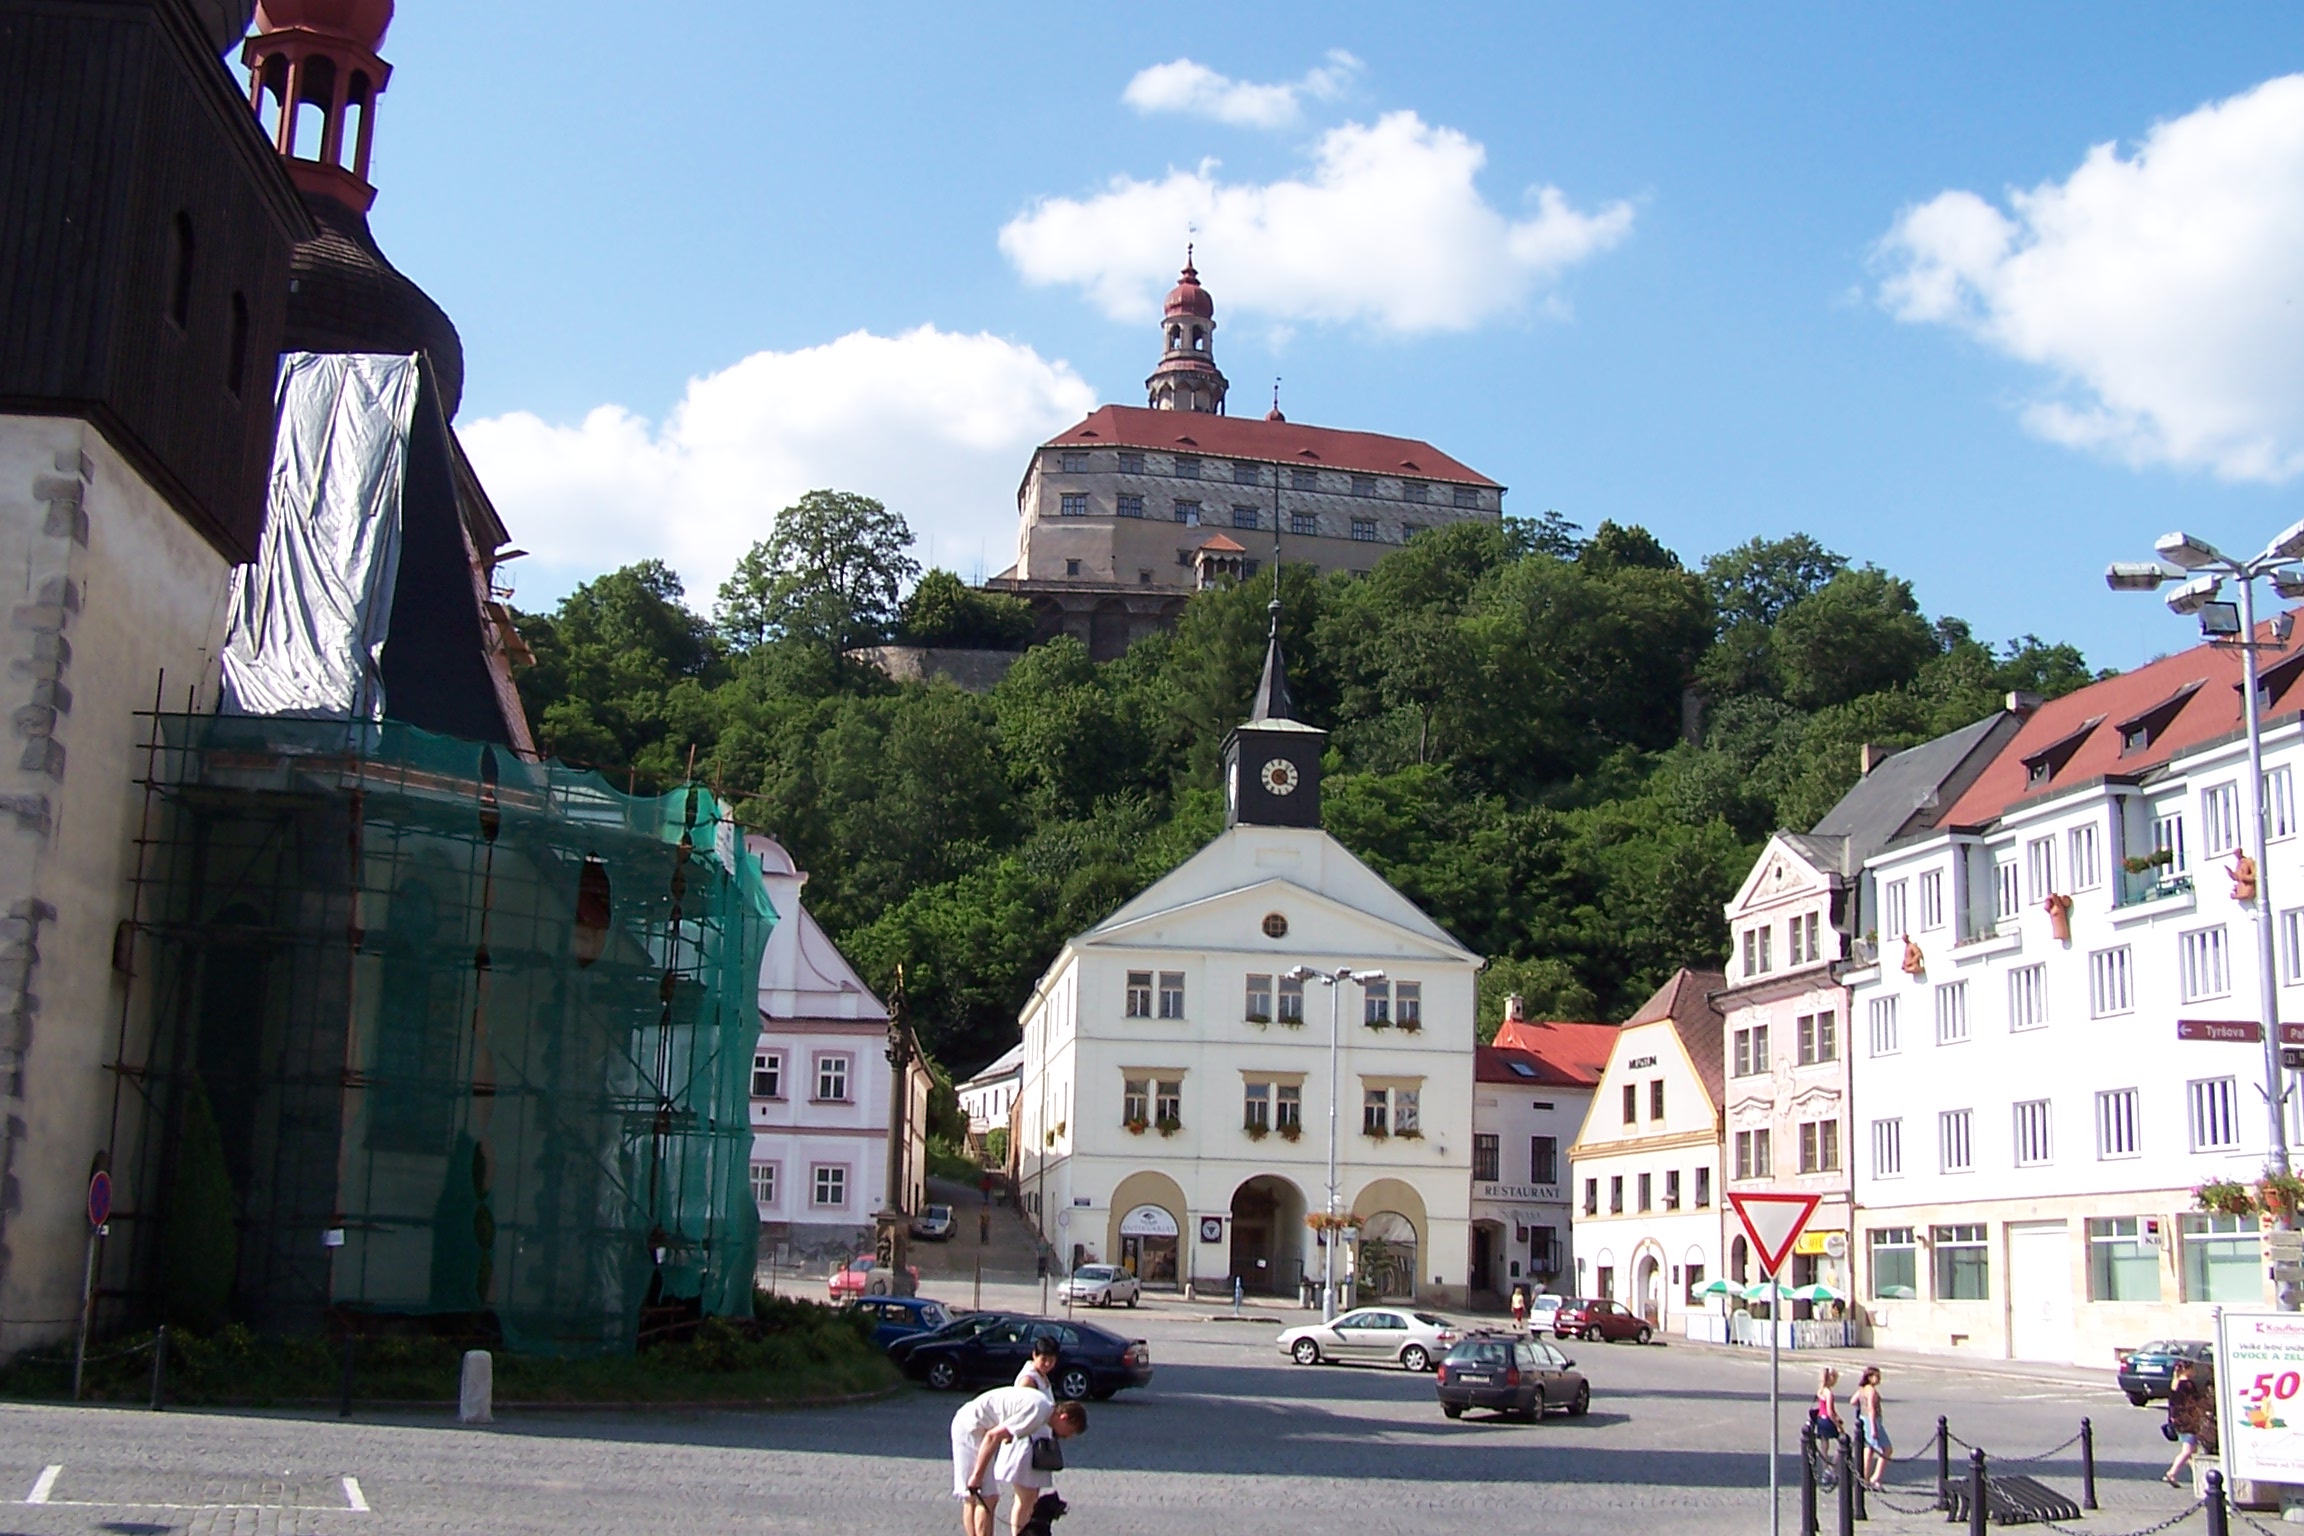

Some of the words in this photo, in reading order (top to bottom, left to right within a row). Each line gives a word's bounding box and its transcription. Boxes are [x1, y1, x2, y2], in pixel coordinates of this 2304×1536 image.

[2205, 1025, 2245, 1039] Tyršova
[2290, 1028, 2304, 1039] Pa
[1629, 1055, 1657, 1070] MUZEUM
[1485, 1186, 1560, 1199] RESTAURANT
[2145, 1236, 2162, 1245] KB
[2232, 1351, 2268, 1360] OVOCE
[2272, 1352, 2280, 1361] A
[2283, 1353, 2304, 1361] ZEL
